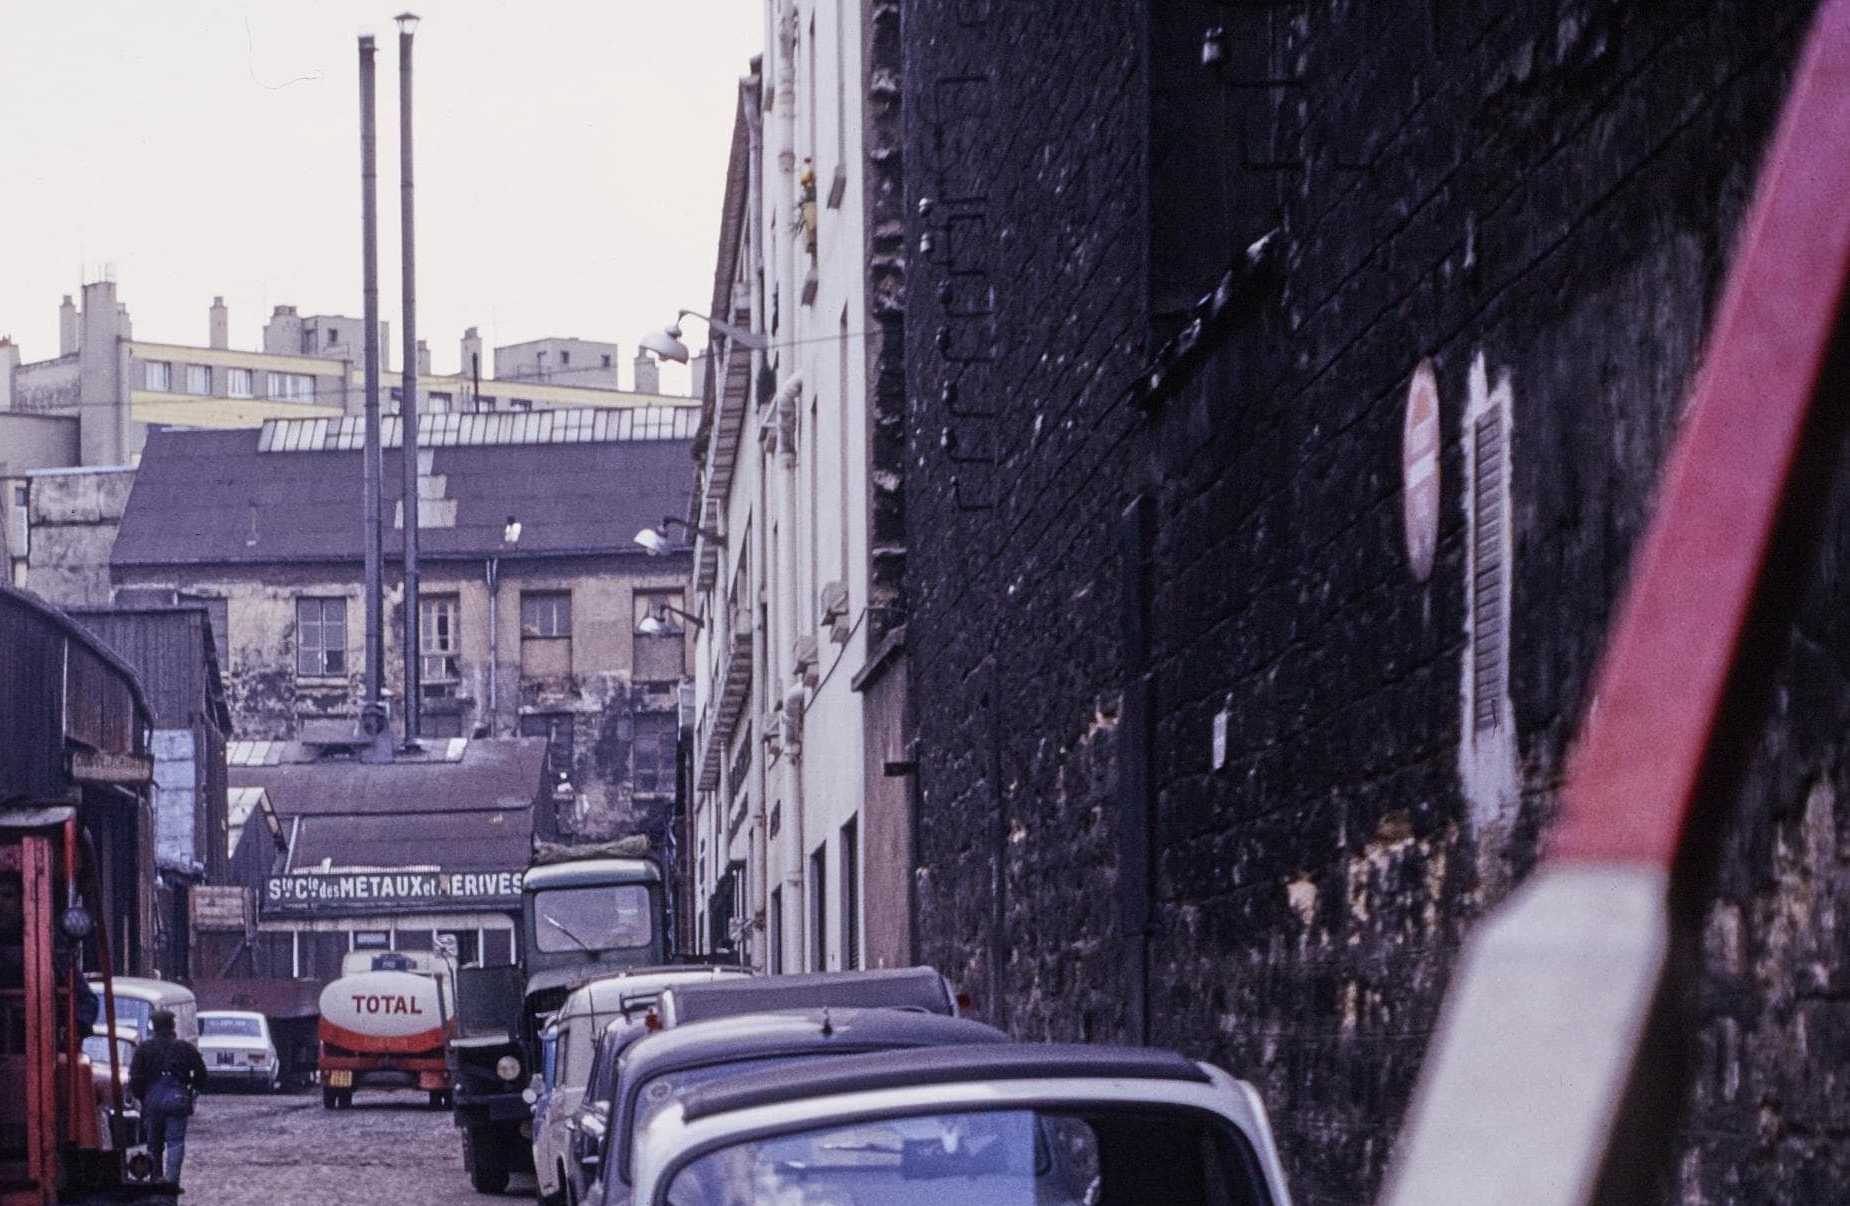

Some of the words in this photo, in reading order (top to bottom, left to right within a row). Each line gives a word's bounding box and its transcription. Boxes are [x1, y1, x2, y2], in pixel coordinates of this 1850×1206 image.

[319, 881, 340, 898] des
[340, 875, 422, 899] METAUX
[423, 878, 436, 896] et
[352, 994, 422, 1014] TOTAL
